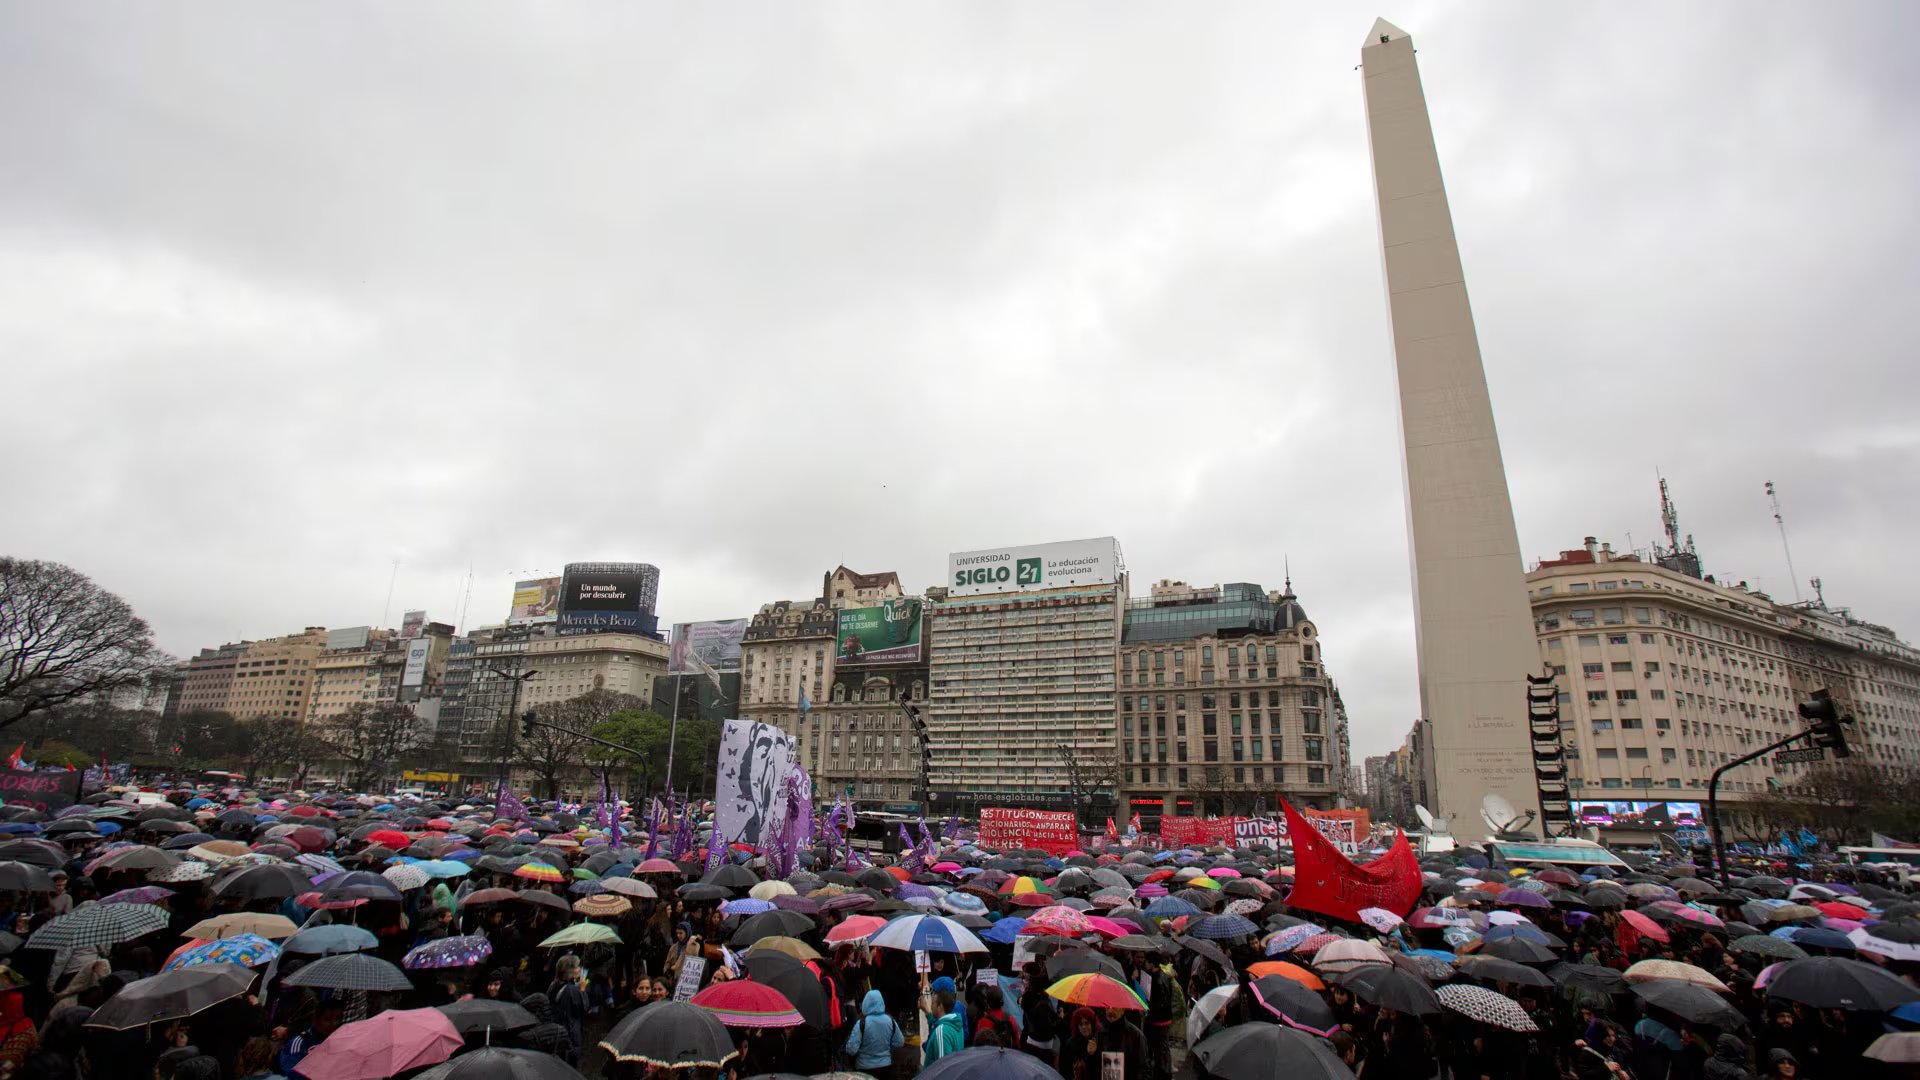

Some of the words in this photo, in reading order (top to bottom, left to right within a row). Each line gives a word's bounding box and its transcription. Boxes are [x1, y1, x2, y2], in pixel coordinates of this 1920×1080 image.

[956, 554, 1011, 566] UNIVERSIDAD
[1048, 560, 1057, 568] La
[1058, 556, 1099, 567] educación
[955, 566, 1010, 586] SIGLO
[1019, 563, 1038, 583] 21
[1048, 566, 1092, 577] evoluciona
[579, 592, 592, 600] por
[592, 591, 626, 599] descubrir
[884, 604, 913, 623] Quick
[1036, 822, 1070, 830] AMPARAN
[1059, 833, 1074, 841] LAS
[980, 838, 1023, 849] MUJERES
